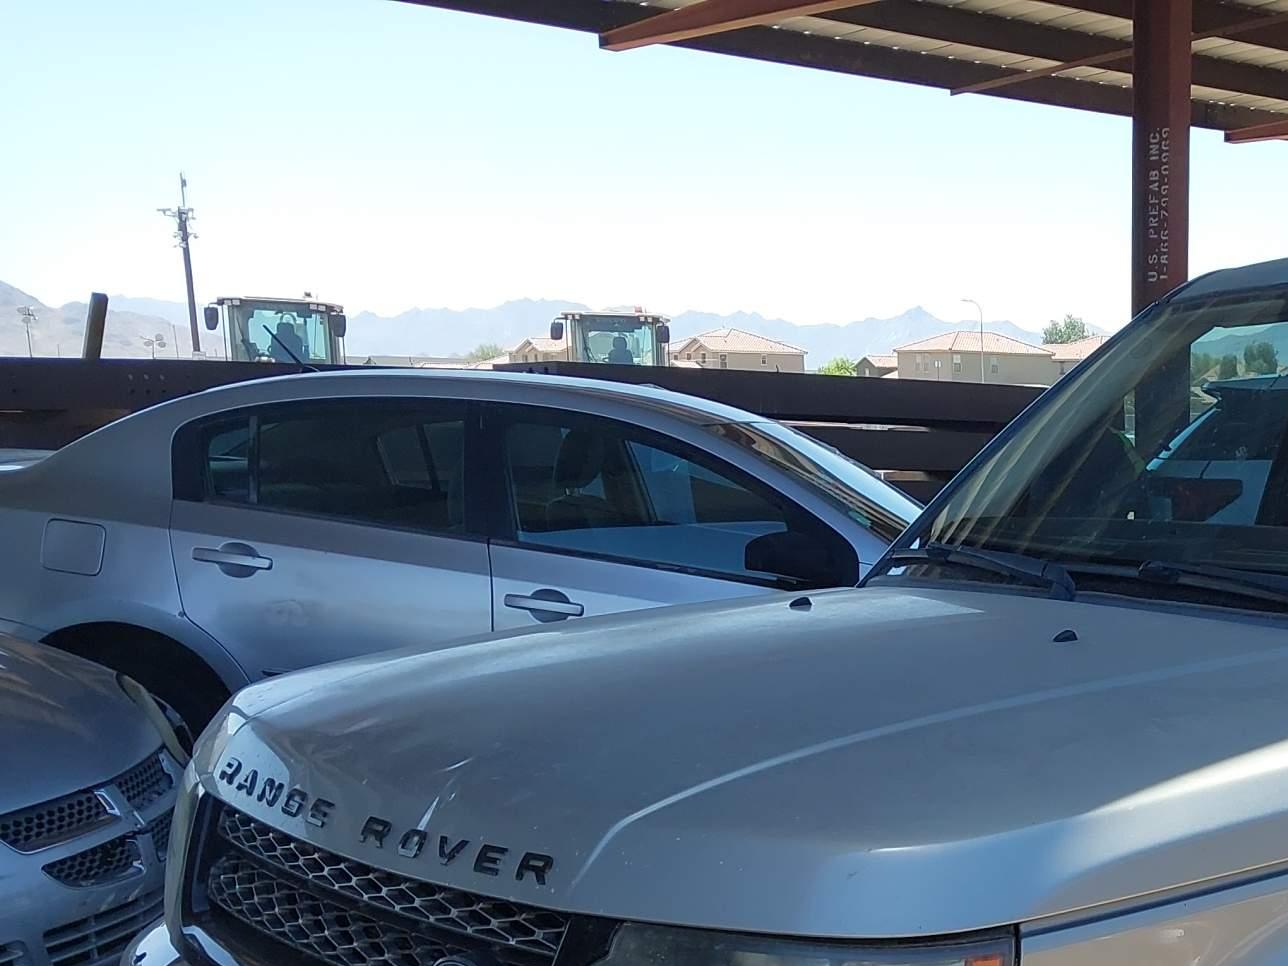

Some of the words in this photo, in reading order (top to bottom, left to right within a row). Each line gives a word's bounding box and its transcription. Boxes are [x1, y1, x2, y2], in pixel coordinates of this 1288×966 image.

[1149, 127, 1161, 161] INC.
[1148, 169, 1160, 238] PREFAB
[1147, 247, 1159, 282] U.S.
[218, 756, 336, 829] RANGE
[359, 815, 555, 886] ROVER
